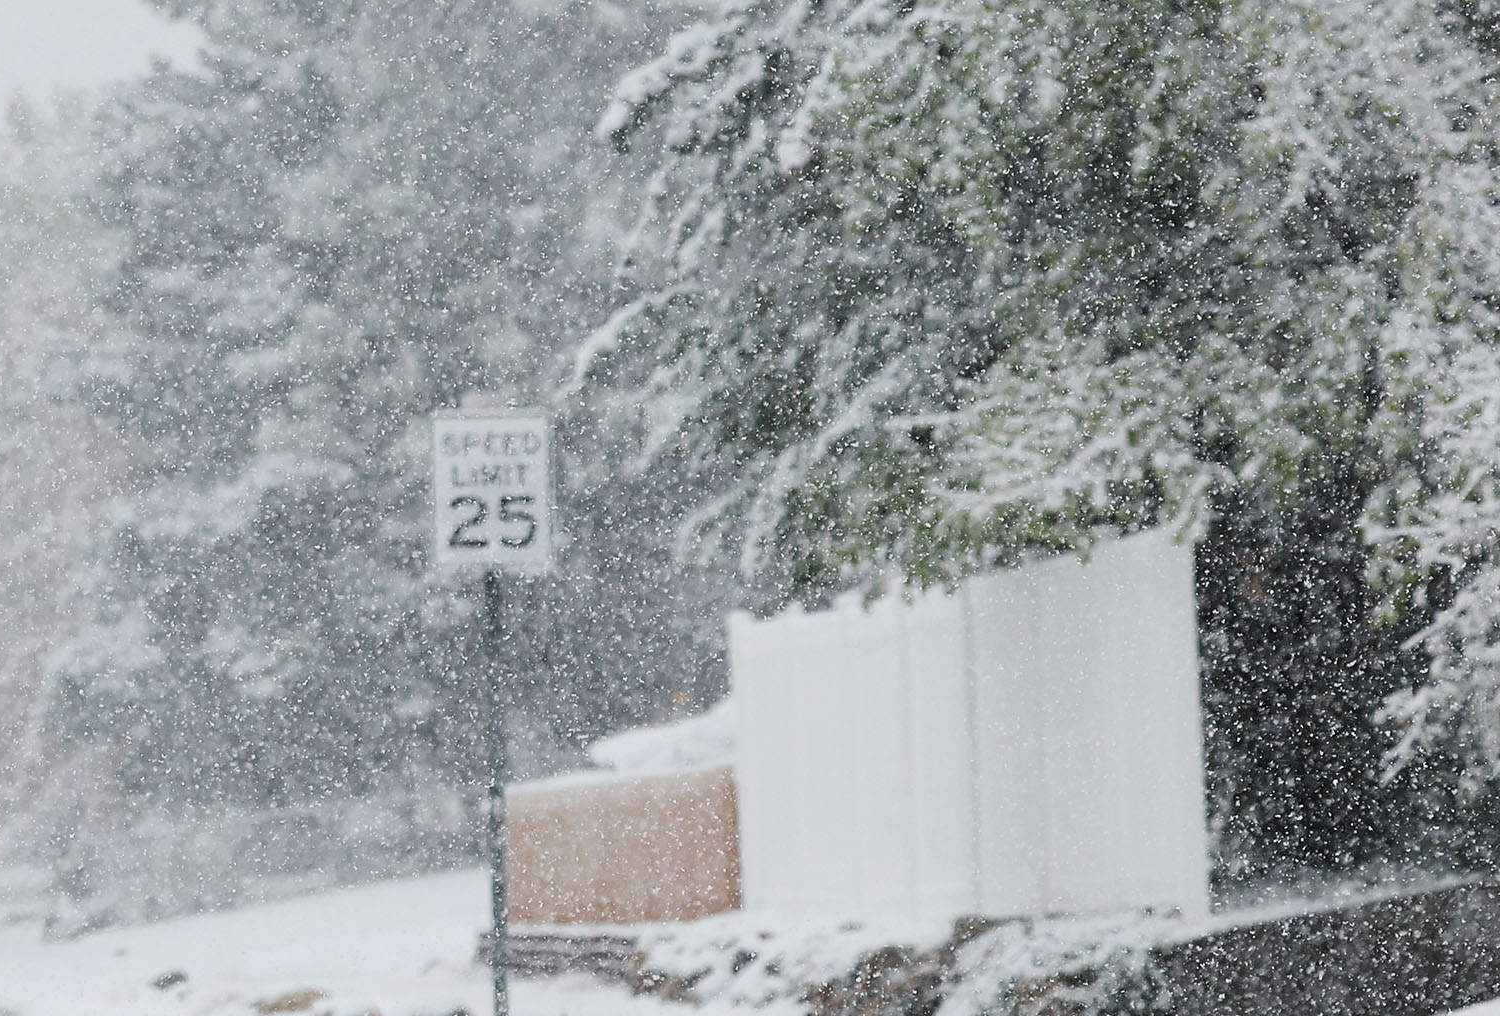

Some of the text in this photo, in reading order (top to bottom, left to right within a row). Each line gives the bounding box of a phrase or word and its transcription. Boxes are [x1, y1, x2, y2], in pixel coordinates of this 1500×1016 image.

[443, 432, 541, 456] SPEED
[451, 464, 528, 487] LIMIT
[449, 495, 538, 548] 25
